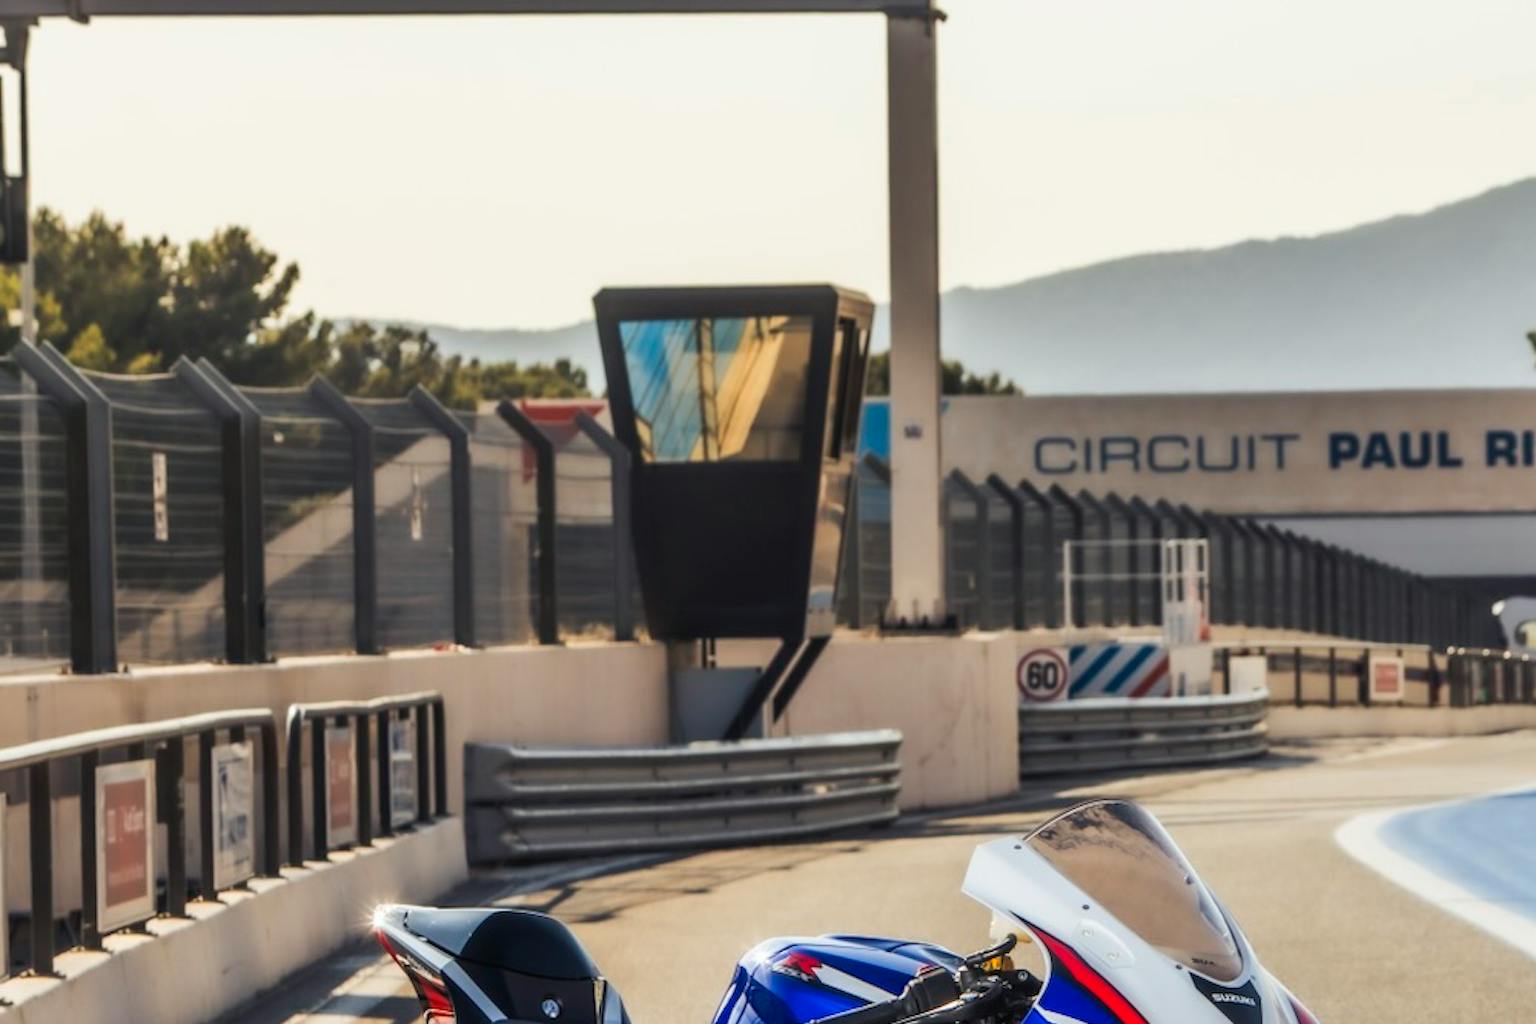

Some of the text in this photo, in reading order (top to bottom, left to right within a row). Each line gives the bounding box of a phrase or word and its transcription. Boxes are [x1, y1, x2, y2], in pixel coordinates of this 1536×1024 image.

[1034, 434, 1301, 475] CIRCUIT
[1328, 431, 1464, 470] PAUL
[1027, 660, 1058, 690] 60
[1211, 992, 1257, 1006] SUZUKI
